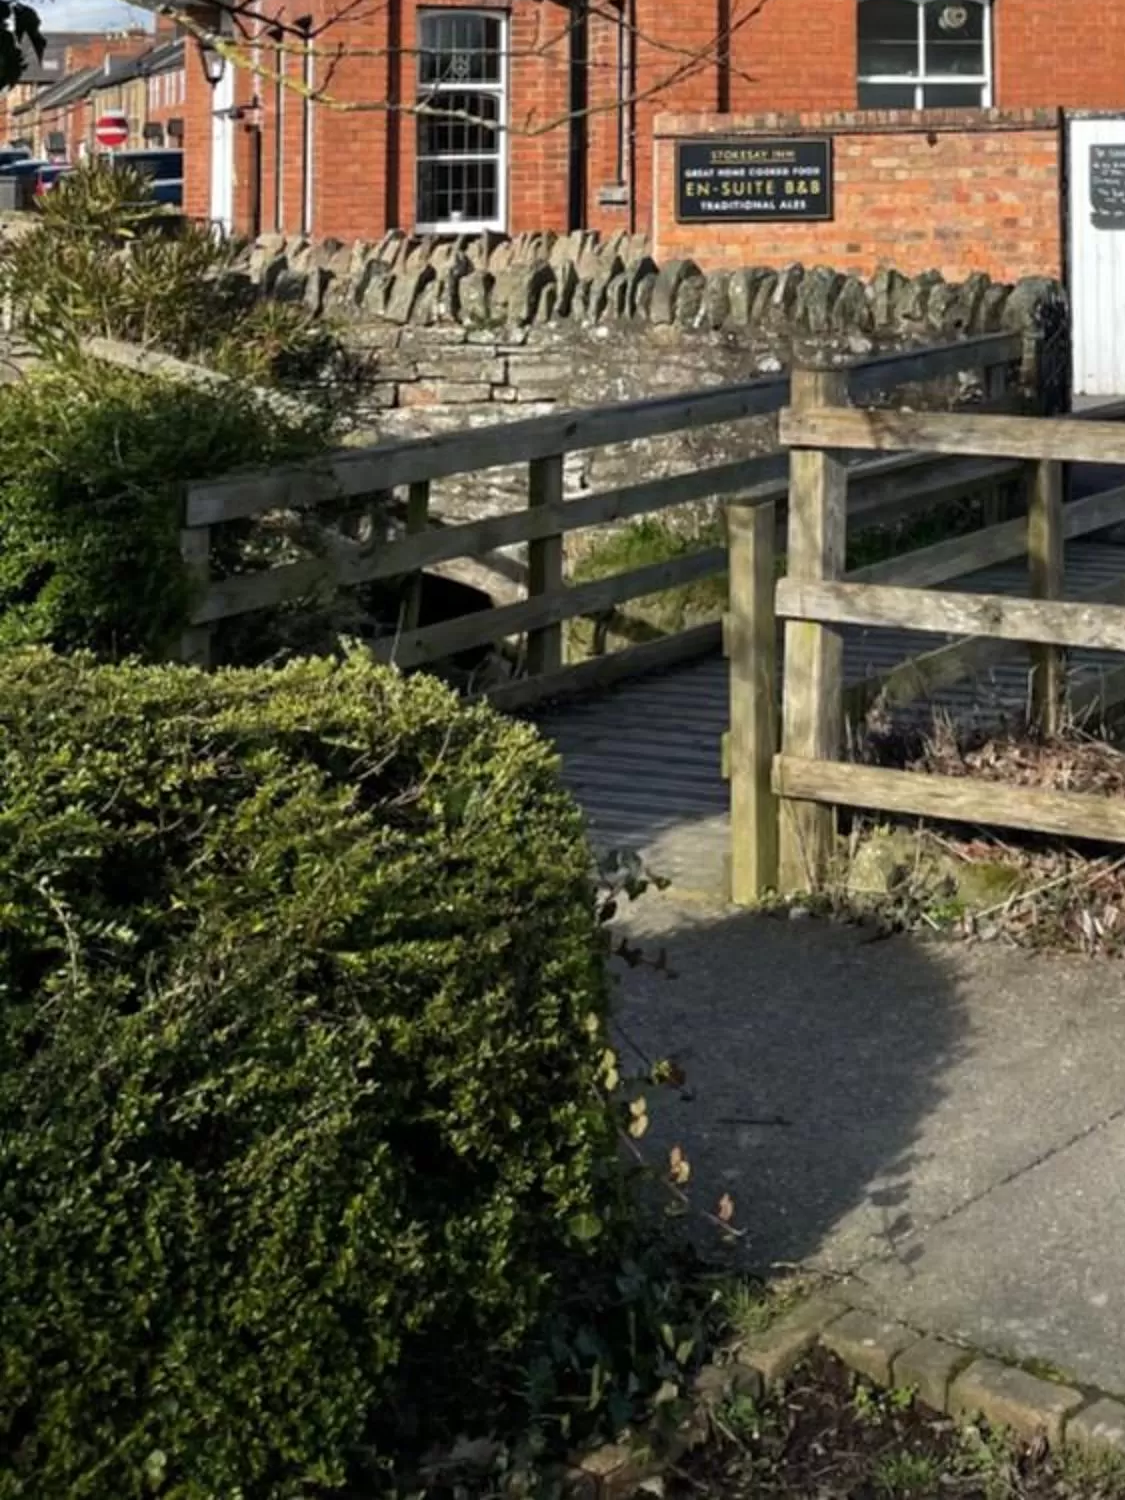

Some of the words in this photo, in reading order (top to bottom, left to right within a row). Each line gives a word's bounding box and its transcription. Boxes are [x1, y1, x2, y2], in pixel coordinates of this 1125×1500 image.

[684, 167, 714, 178] GREAT
[717, 167, 745, 177] HOME
[748, 166, 790, 177] COOKED
[792, 166, 821, 176] FOOD
[685, 180, 775, 197] EN-SUITE
[784, 180, 821, 195] B&B
[700, 200, 776, 211] TRADITIONAL
[779, 199, 807, 210] ALES
